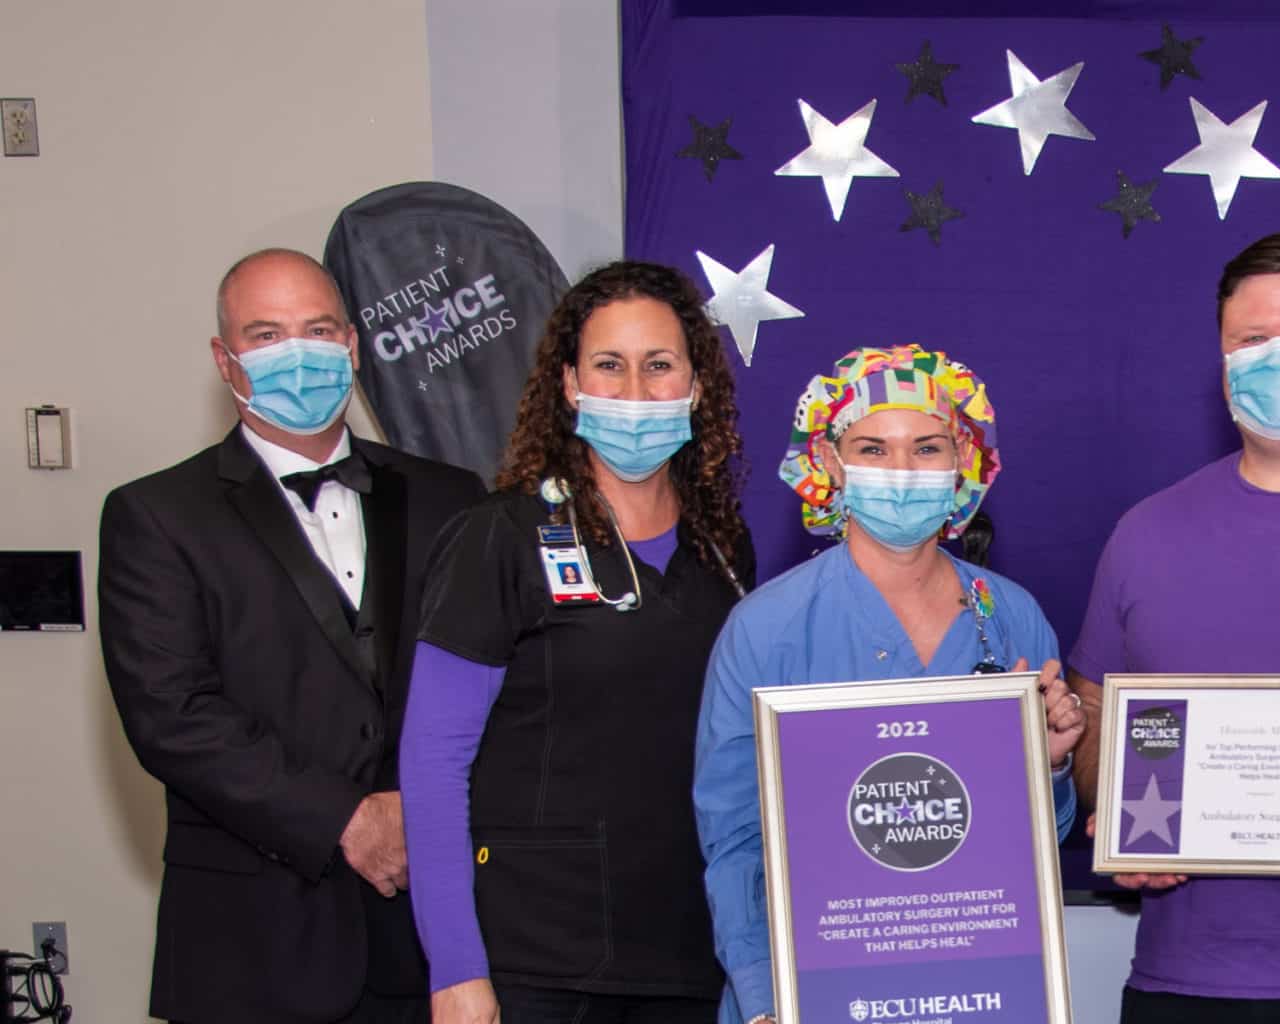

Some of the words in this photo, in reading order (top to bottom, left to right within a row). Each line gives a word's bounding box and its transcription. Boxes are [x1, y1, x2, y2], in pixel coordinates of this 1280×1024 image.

[359, 265, 451, 330] PATIENT
[425, 308, 517, 373] AWARDS
[876, 720, 929, 738] 2022
[1133, 718, 1169, 727] PATIENT
[1143, 739, 1180, 748] AWARDS
[855, 780, 931, 799] PATIENT
[885, 823, 964, 843] AWARDS
[828, 898, 861, 910] MOST
[865, 894, 928, 908] IMPROVED
[931, 889, 1005, 904] OUTPATIENT
[819, 911, 900, 926] AMBULATORY
[904, 907, 960, 921] SURGERY
[962, 904, 989, 916] UNIT
[992, 903, 1016, 914] FOR
[872, 927, 881, 937] A
[883, 923, 929, 936] CARING
[932, 917, 1019, 933] ENVIRONMENT
[865, 941, 896, 953] THAT
[899, 937, 938, 950] HELPS
[870, 999, 916, 1018] ECU
[919, 992, 1001, 1015] HEALTH
